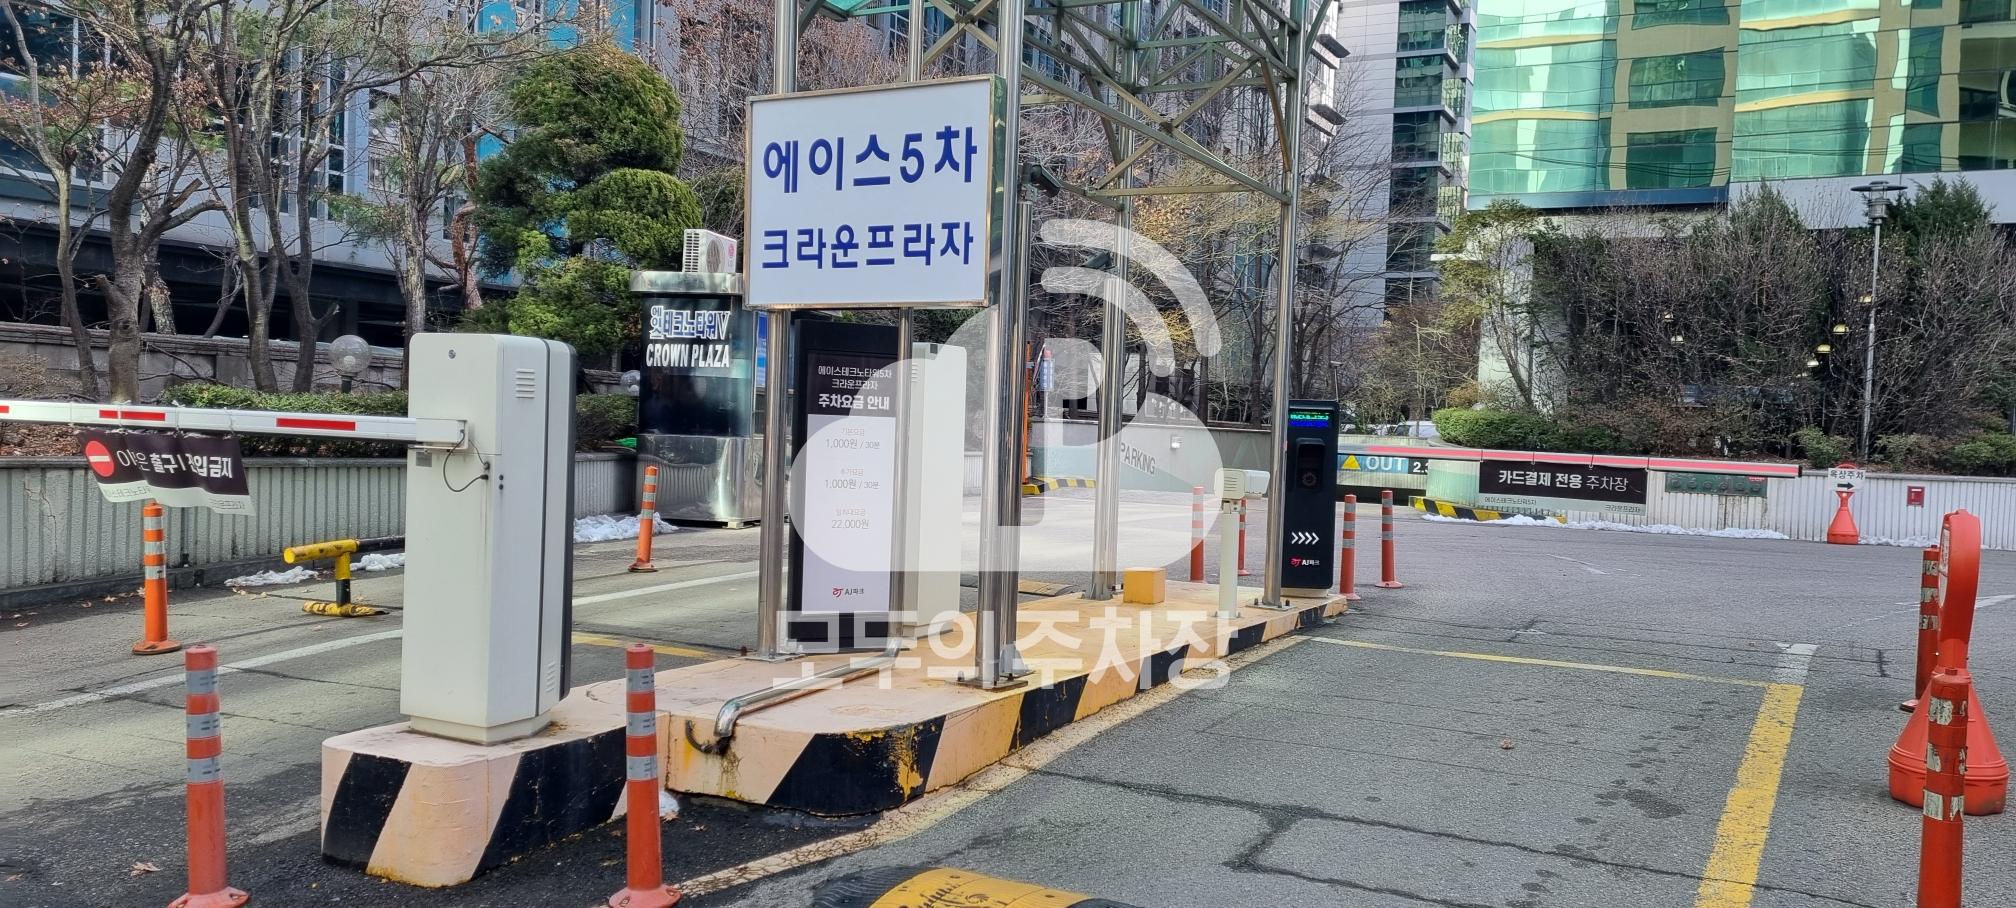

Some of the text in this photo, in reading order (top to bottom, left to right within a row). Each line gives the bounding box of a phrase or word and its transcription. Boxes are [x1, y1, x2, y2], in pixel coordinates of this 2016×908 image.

[763, 125, 978, 193] 에이스5차
[762, 221, 974, 269] 크라운프라자
[645, 343, 731, 368] CROWN PLAZA
[818, 365, 892, 379] 에이스테크노타워5차
[832, 378, 879, 390] 크라운프라자
[818, 393, 890, 411] 주차요금 안내
[116, 449, 151, 472] 이은
[150, 452, 178, 474] 출구
[1365, 456, 1409, 471] OUT
[1498, 470, 1629, 492] 카드결제 전용 주차장
[1830, 469, 1864, 480] 옥상주차
